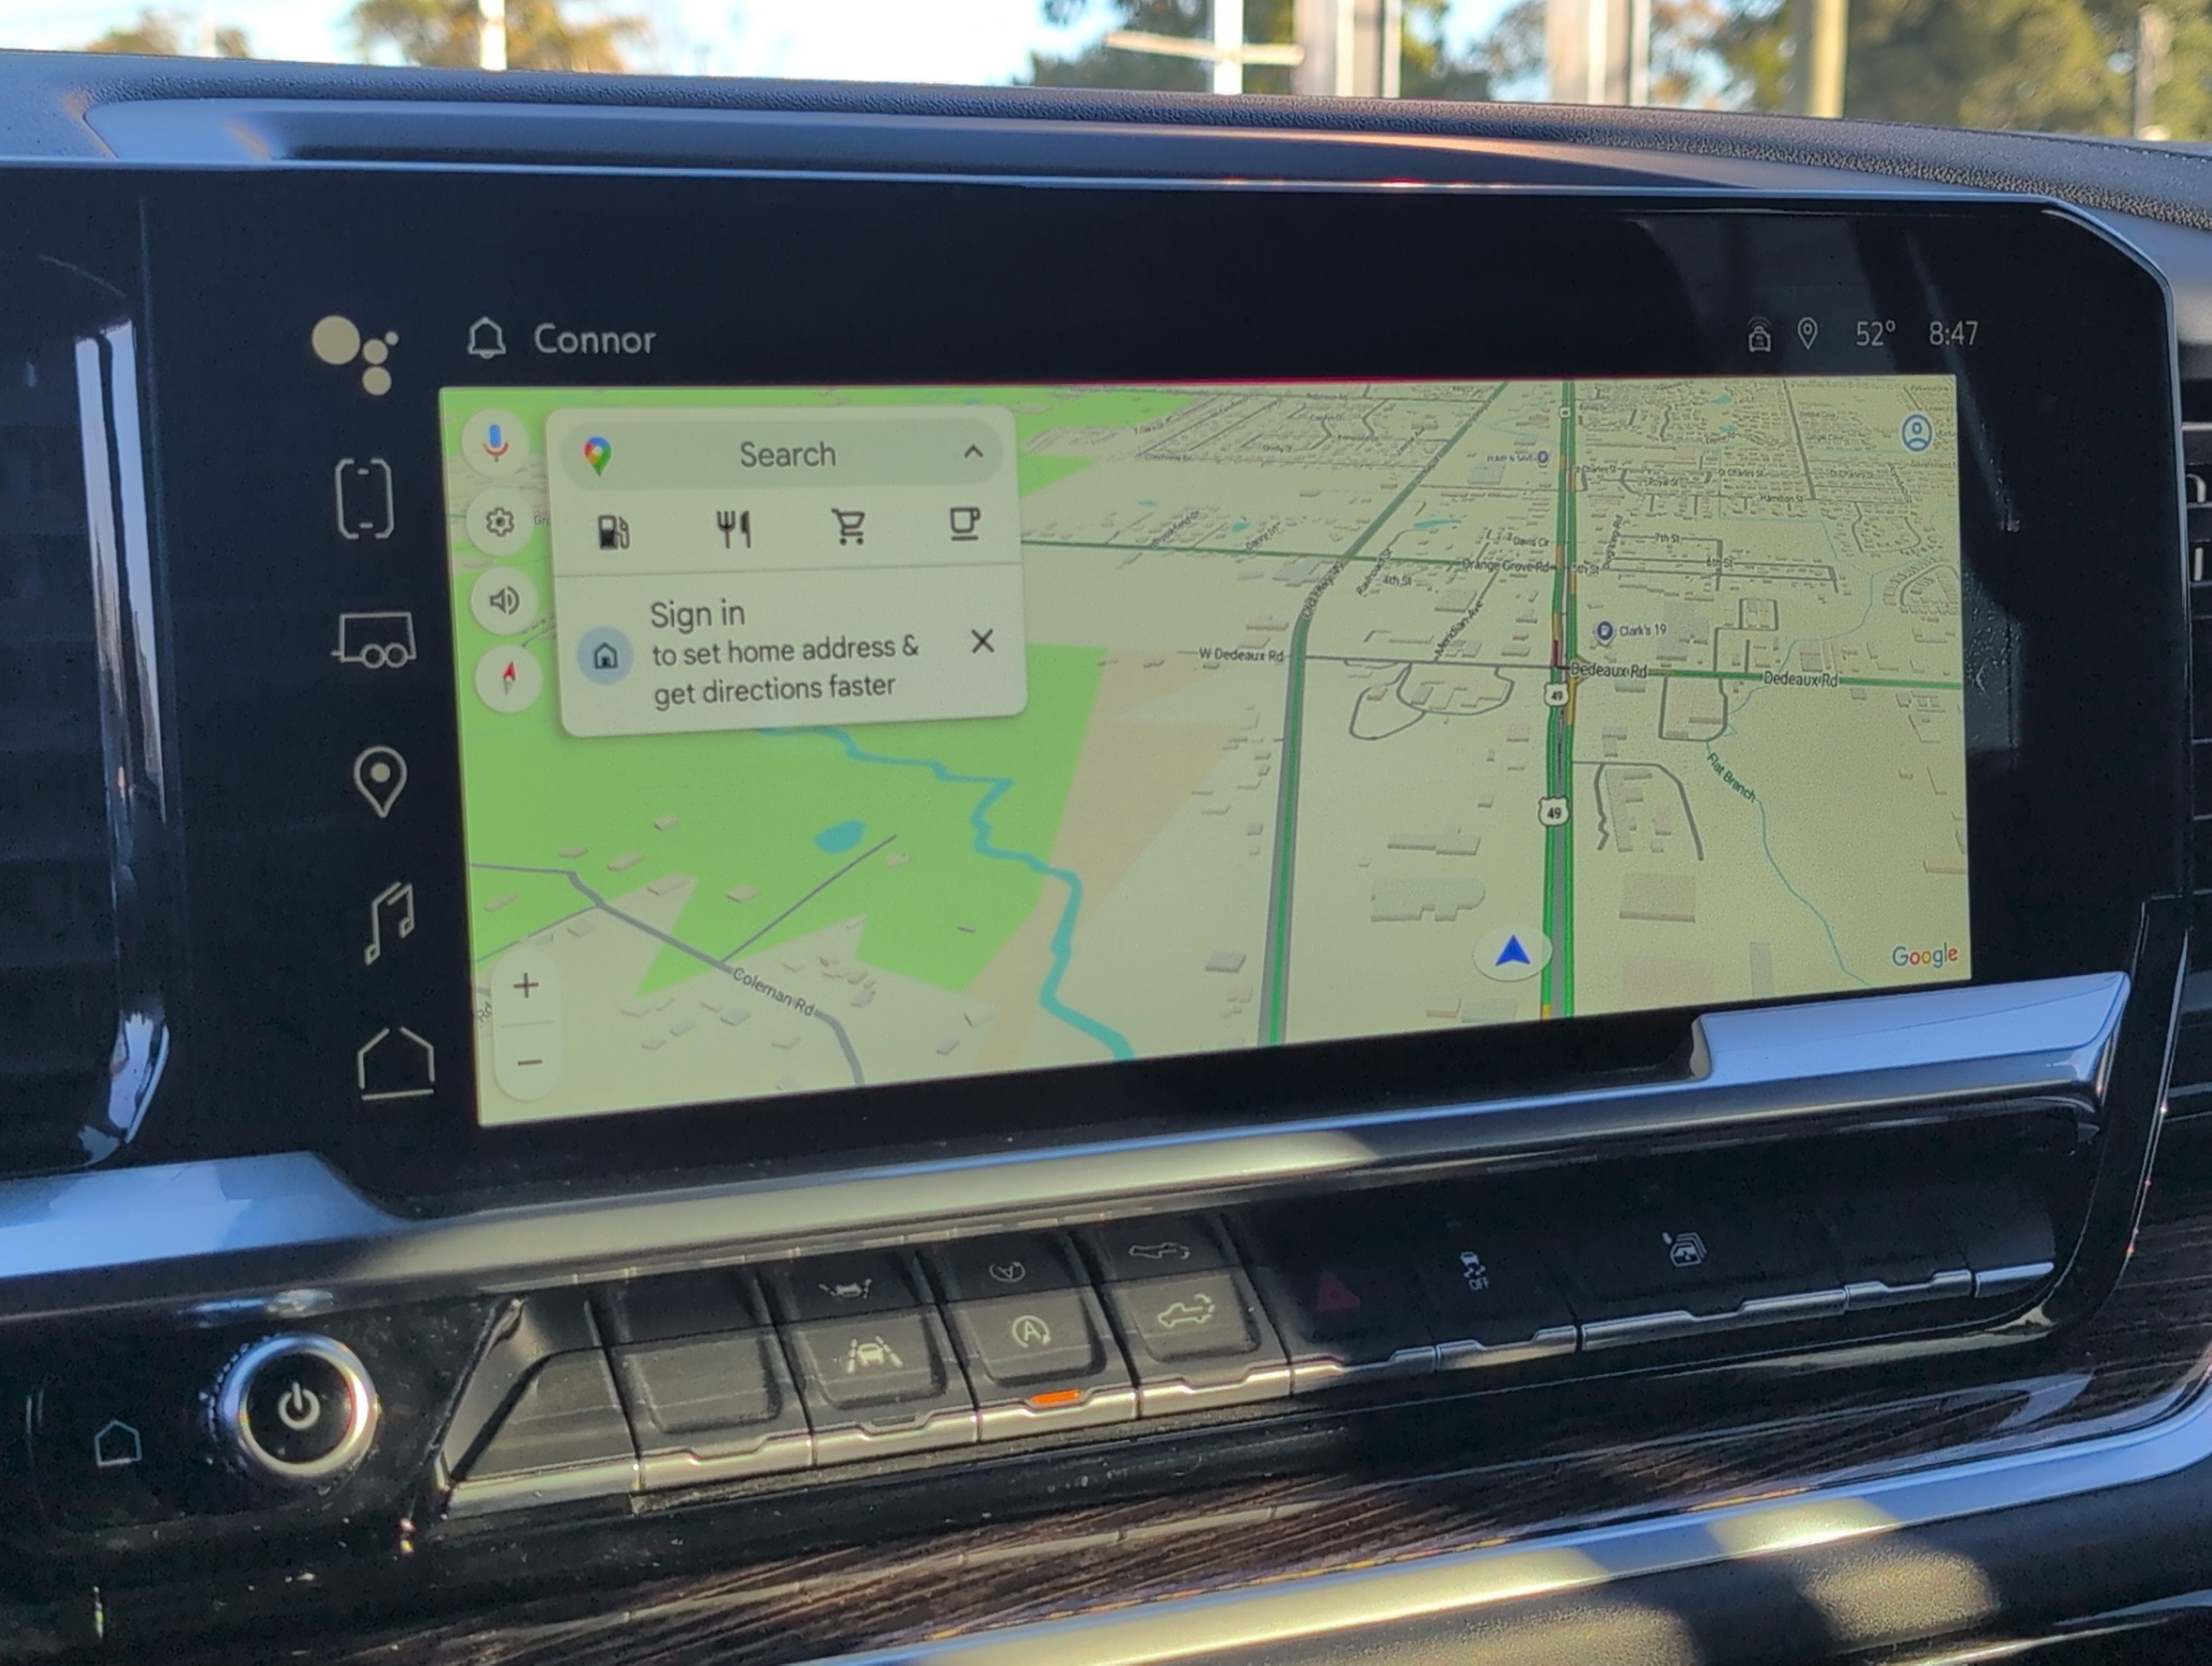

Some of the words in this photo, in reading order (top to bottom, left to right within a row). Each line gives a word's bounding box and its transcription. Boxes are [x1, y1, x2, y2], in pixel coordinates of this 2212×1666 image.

[533, 324, 657, 355] Connor
[1856, 320, 1896, 347] 52°
[1929, 320, 1978, 347] 8:47
[740, 439, 837, 469] Search
[1655, 533, 1670, 543] 7th
[1671, 534, 1680, 543] St
[1462, 558, 1501, 573] Orange
[1502, 559, 1535, 572] Grove
[1535, 561, 1550, 573] Rd
[1590, 565, 1600, 575] St
[1724, 557, 1733, 568] St
[1383, 575, 1399, 586] 4th
[1400, 575, 1412, 586] St
[651, 600, 712, 635] Sign
[721, 598, 745, 626] in
[1435, 617, 1469, 657] Meridian
[1468, 600, 1483, 619] Ave
[1654, 624, 1667, 636] 19
[652, 645, 677, 667] to
[683, 643, 722, 665] set
[728, 640, 795, 663] home
[802, 635, 896, 661] address
[902, 633, 920, 657] &
[1199, 647, 1211, 659] W
[1214, 647, 1265, 662] Dedeaux
[1268, 650, 1284, 663] Rd
[1630, 664, 1648, 678] Rd
[1764, 671, 1819, 687] Dedeaux
[1822, 672, 1839, 688] Rd
[654, 683, 696, 712] get
[702, 676, 823, 704] directions
[829, 672, 896, 698] faster
[1551, 690, 1563, 701] 49
[1707, 752, 1725, 776] Flat
[1723, 770, 1756, 803] Branch
[1548, 807, 1561, 819] 49
[1892, 942, 1958, 969] Google
[733, 967, 792, 1007] Coleman
[794, 997, 815, 1017] Rd
